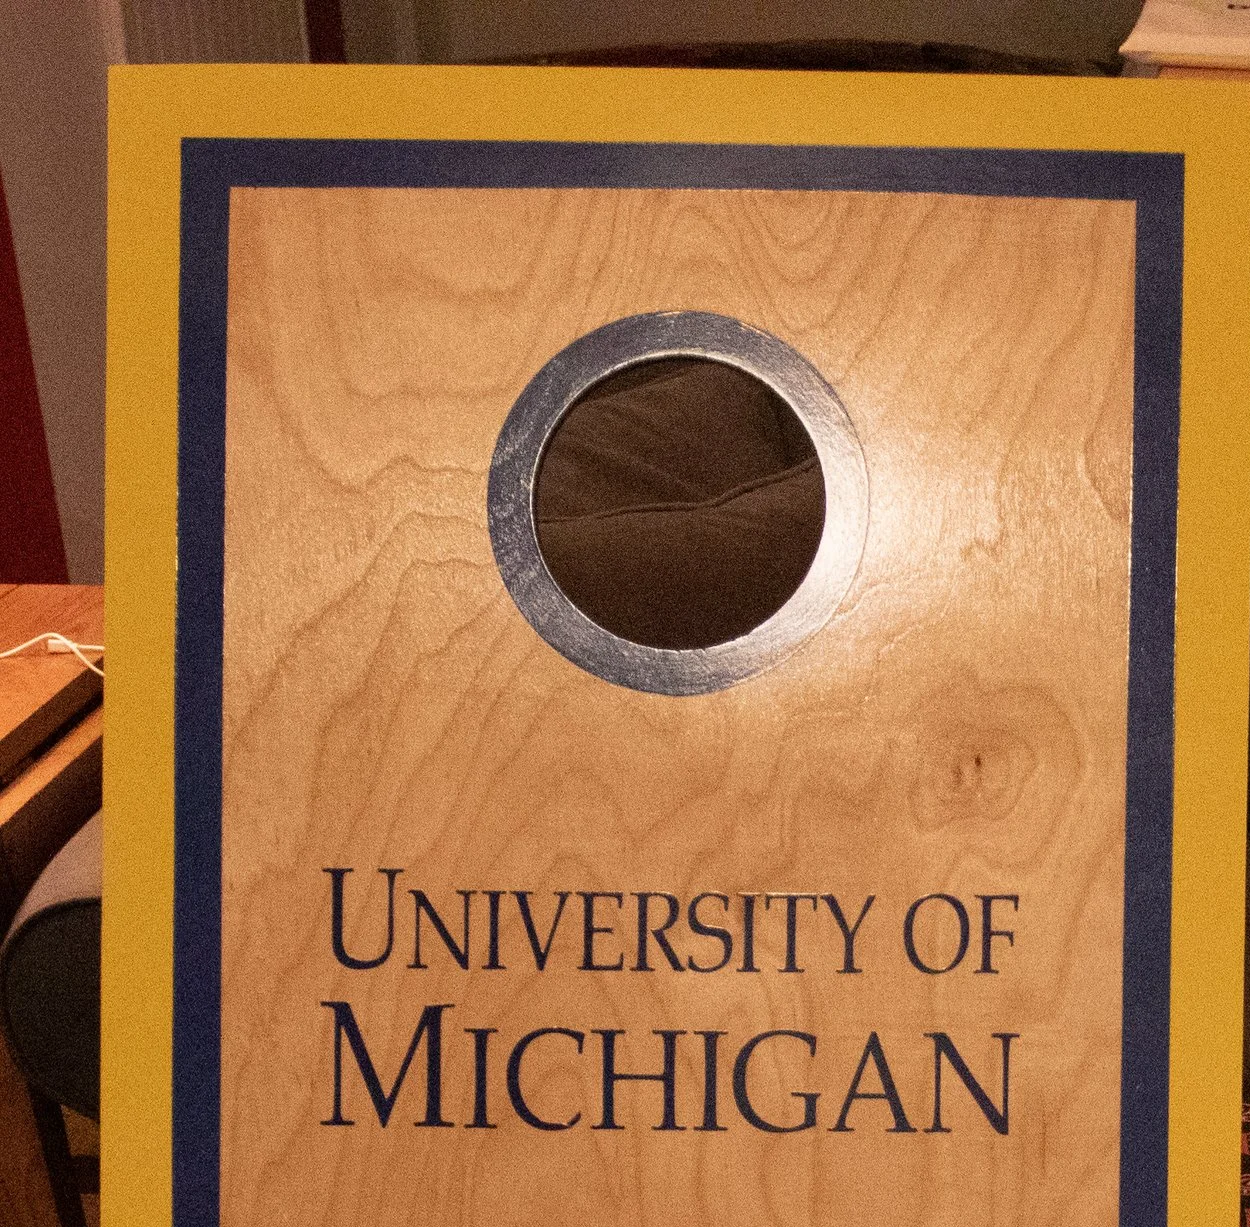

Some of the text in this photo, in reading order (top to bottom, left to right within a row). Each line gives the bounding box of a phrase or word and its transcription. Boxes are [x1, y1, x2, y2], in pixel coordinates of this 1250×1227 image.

[322, 867, 1020, 975] UNIVERSITY OF
[320, 1001, 1021, 1136] MICHIGAN
